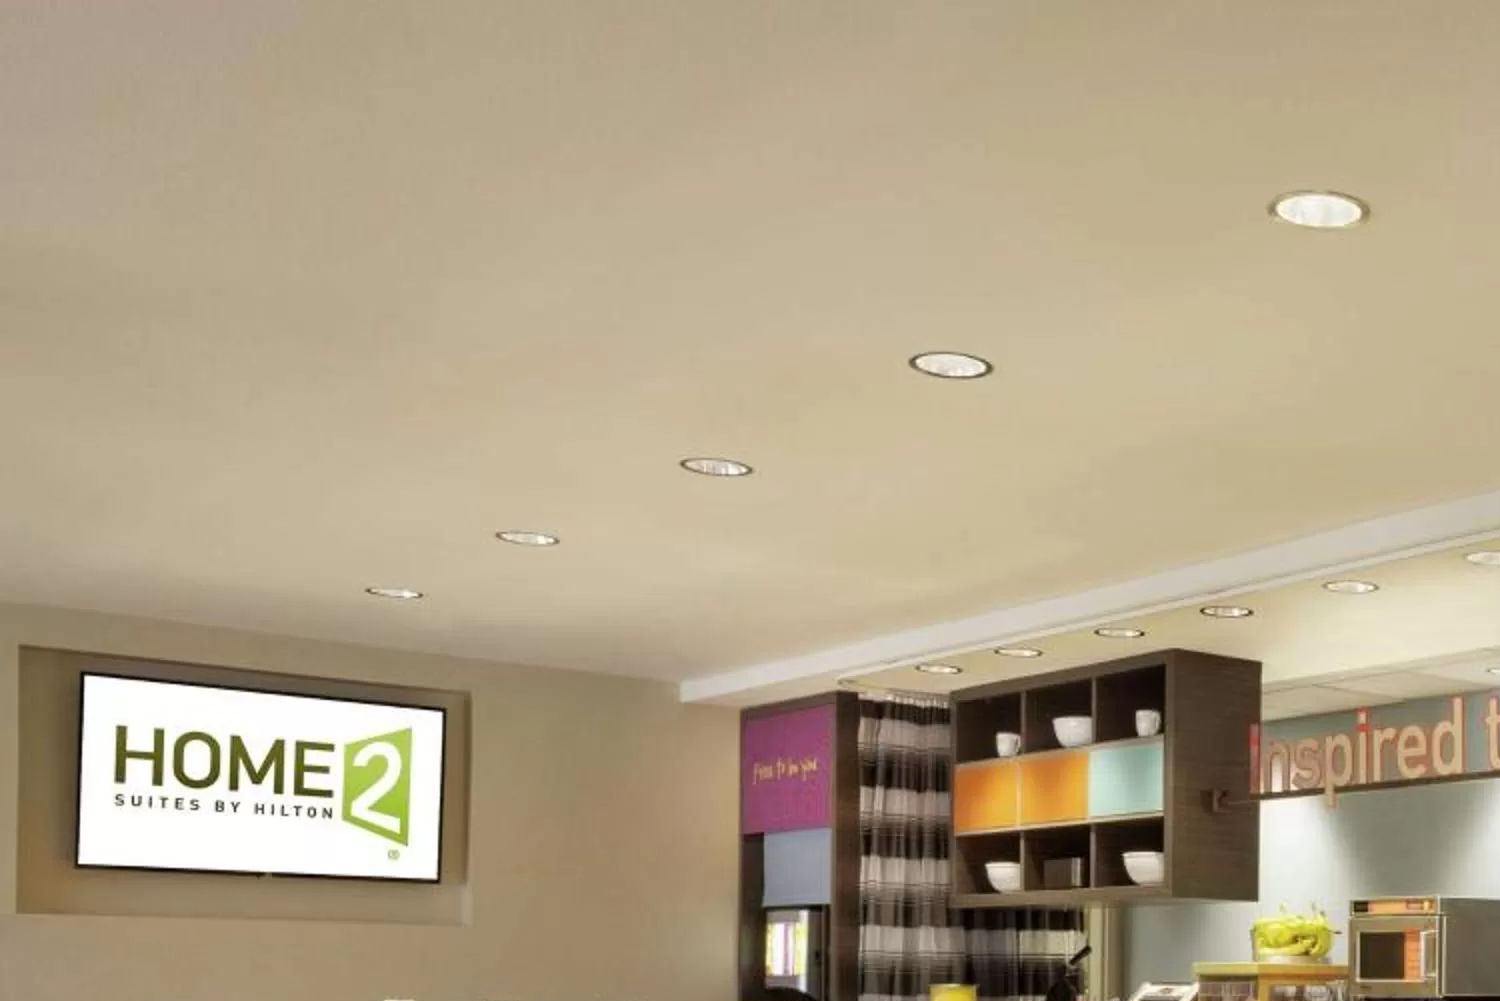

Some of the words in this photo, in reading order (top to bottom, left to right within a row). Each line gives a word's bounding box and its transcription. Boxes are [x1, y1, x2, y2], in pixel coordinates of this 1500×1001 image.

[114, 725, 335, 798] HOME
[351, 740, 402, 835] 2
[114, 793, 201, 811] SUITES
[214, 799, 241, 813] BY
[254, 803, 334, 819] HILTON
